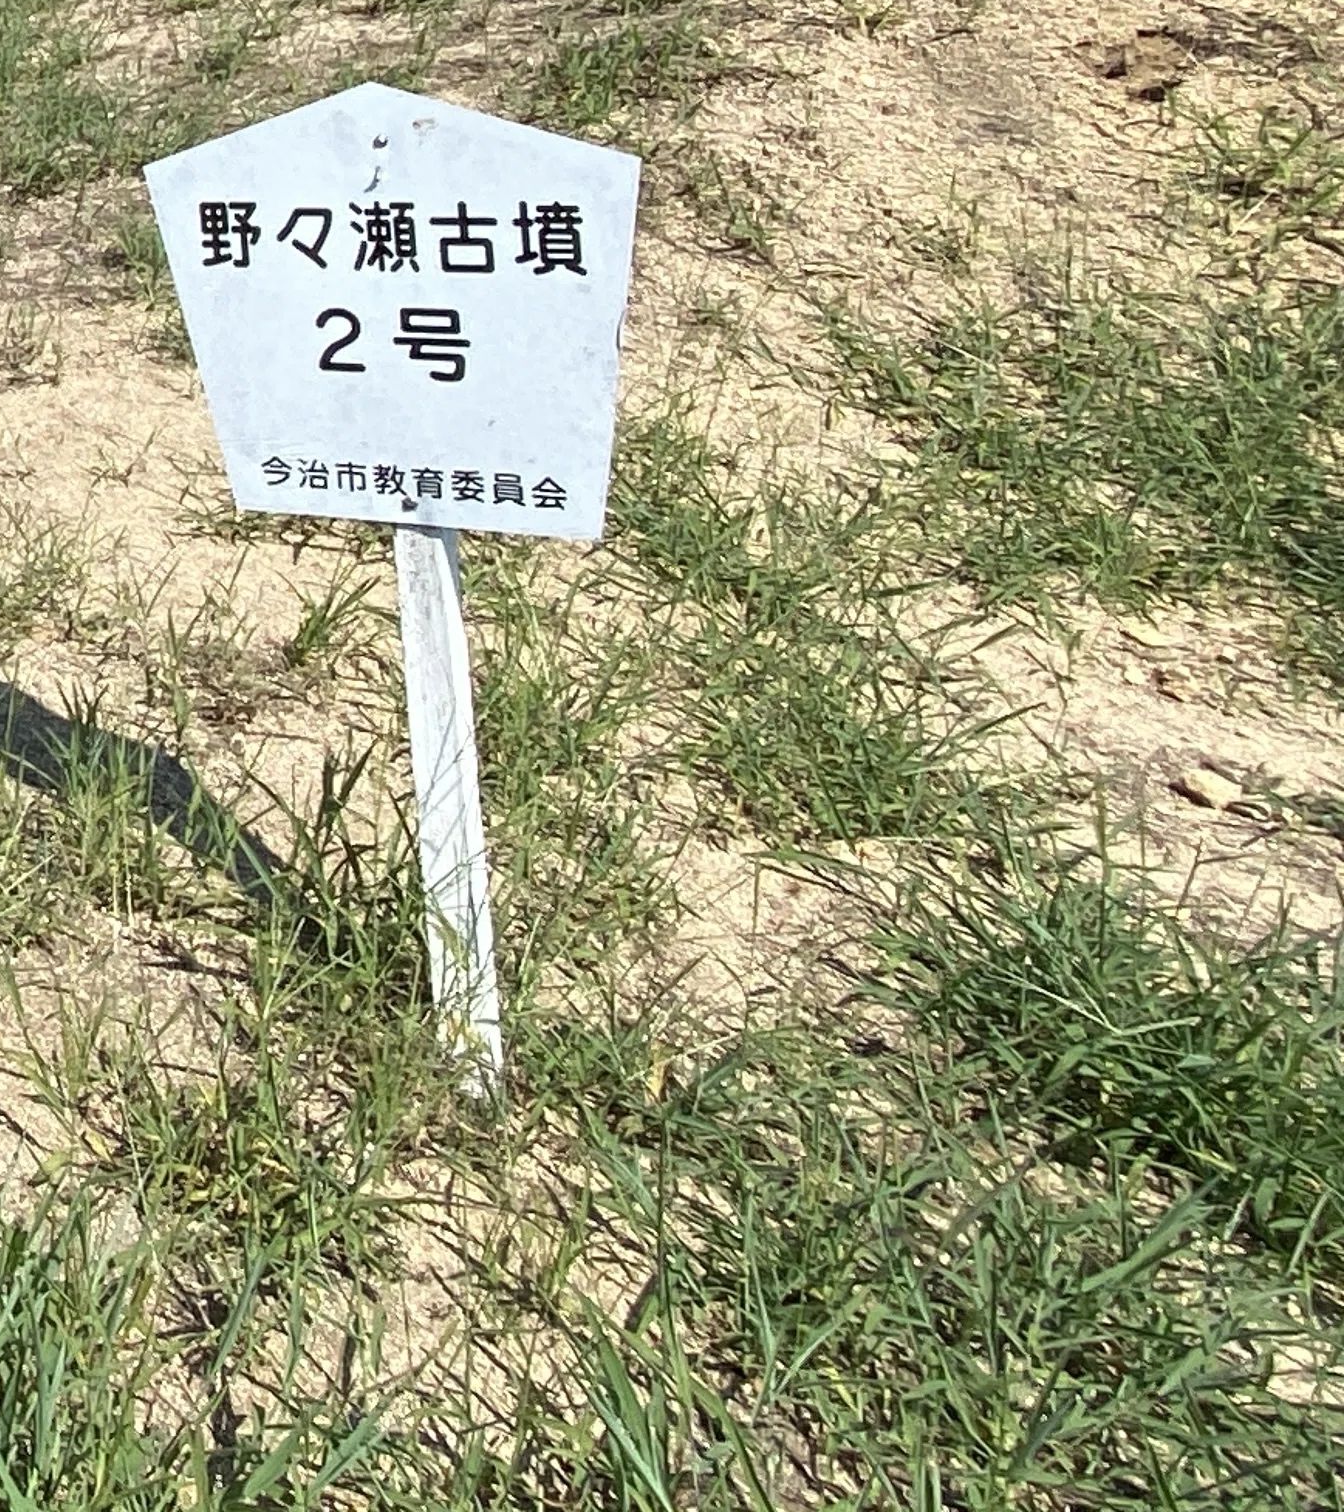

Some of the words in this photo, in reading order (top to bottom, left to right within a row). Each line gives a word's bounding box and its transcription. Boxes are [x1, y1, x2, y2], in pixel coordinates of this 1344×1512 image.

[198, 201, 588, 276] 野々瀬古墳
[315, 307, 471, 382] 2号
[260, 455, 568, 511] 今治市教育委員会
